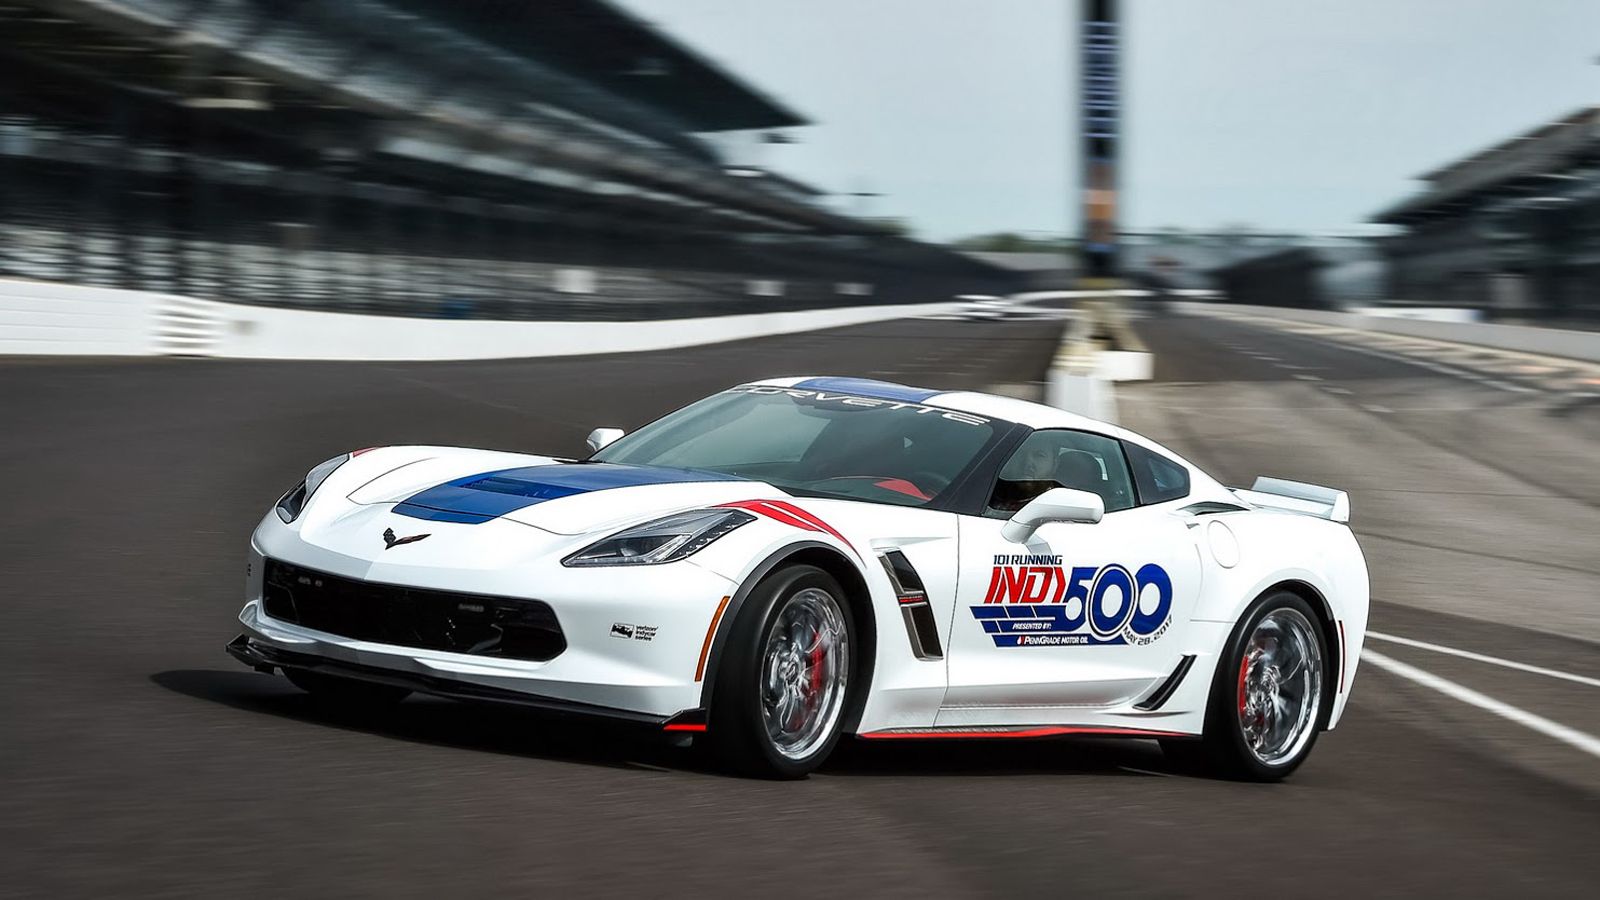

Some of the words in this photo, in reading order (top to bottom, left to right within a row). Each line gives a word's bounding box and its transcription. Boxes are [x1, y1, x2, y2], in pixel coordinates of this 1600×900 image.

[730, 385, 990, 426] CORVETTE
[993, 555, 1012, 566] 101
[1012, 555, 1063, 566] RUNNING
[984, 566, 1067, 604] INDY
[1063, 563, 1173, 638] 500
[1061, 636, 1080, 644] MOTOR
[1080, 636, 1089, 644] OIL
[1123, 625, 1138, 644] MAY
[1153, 614, 1172, 641] 2017
